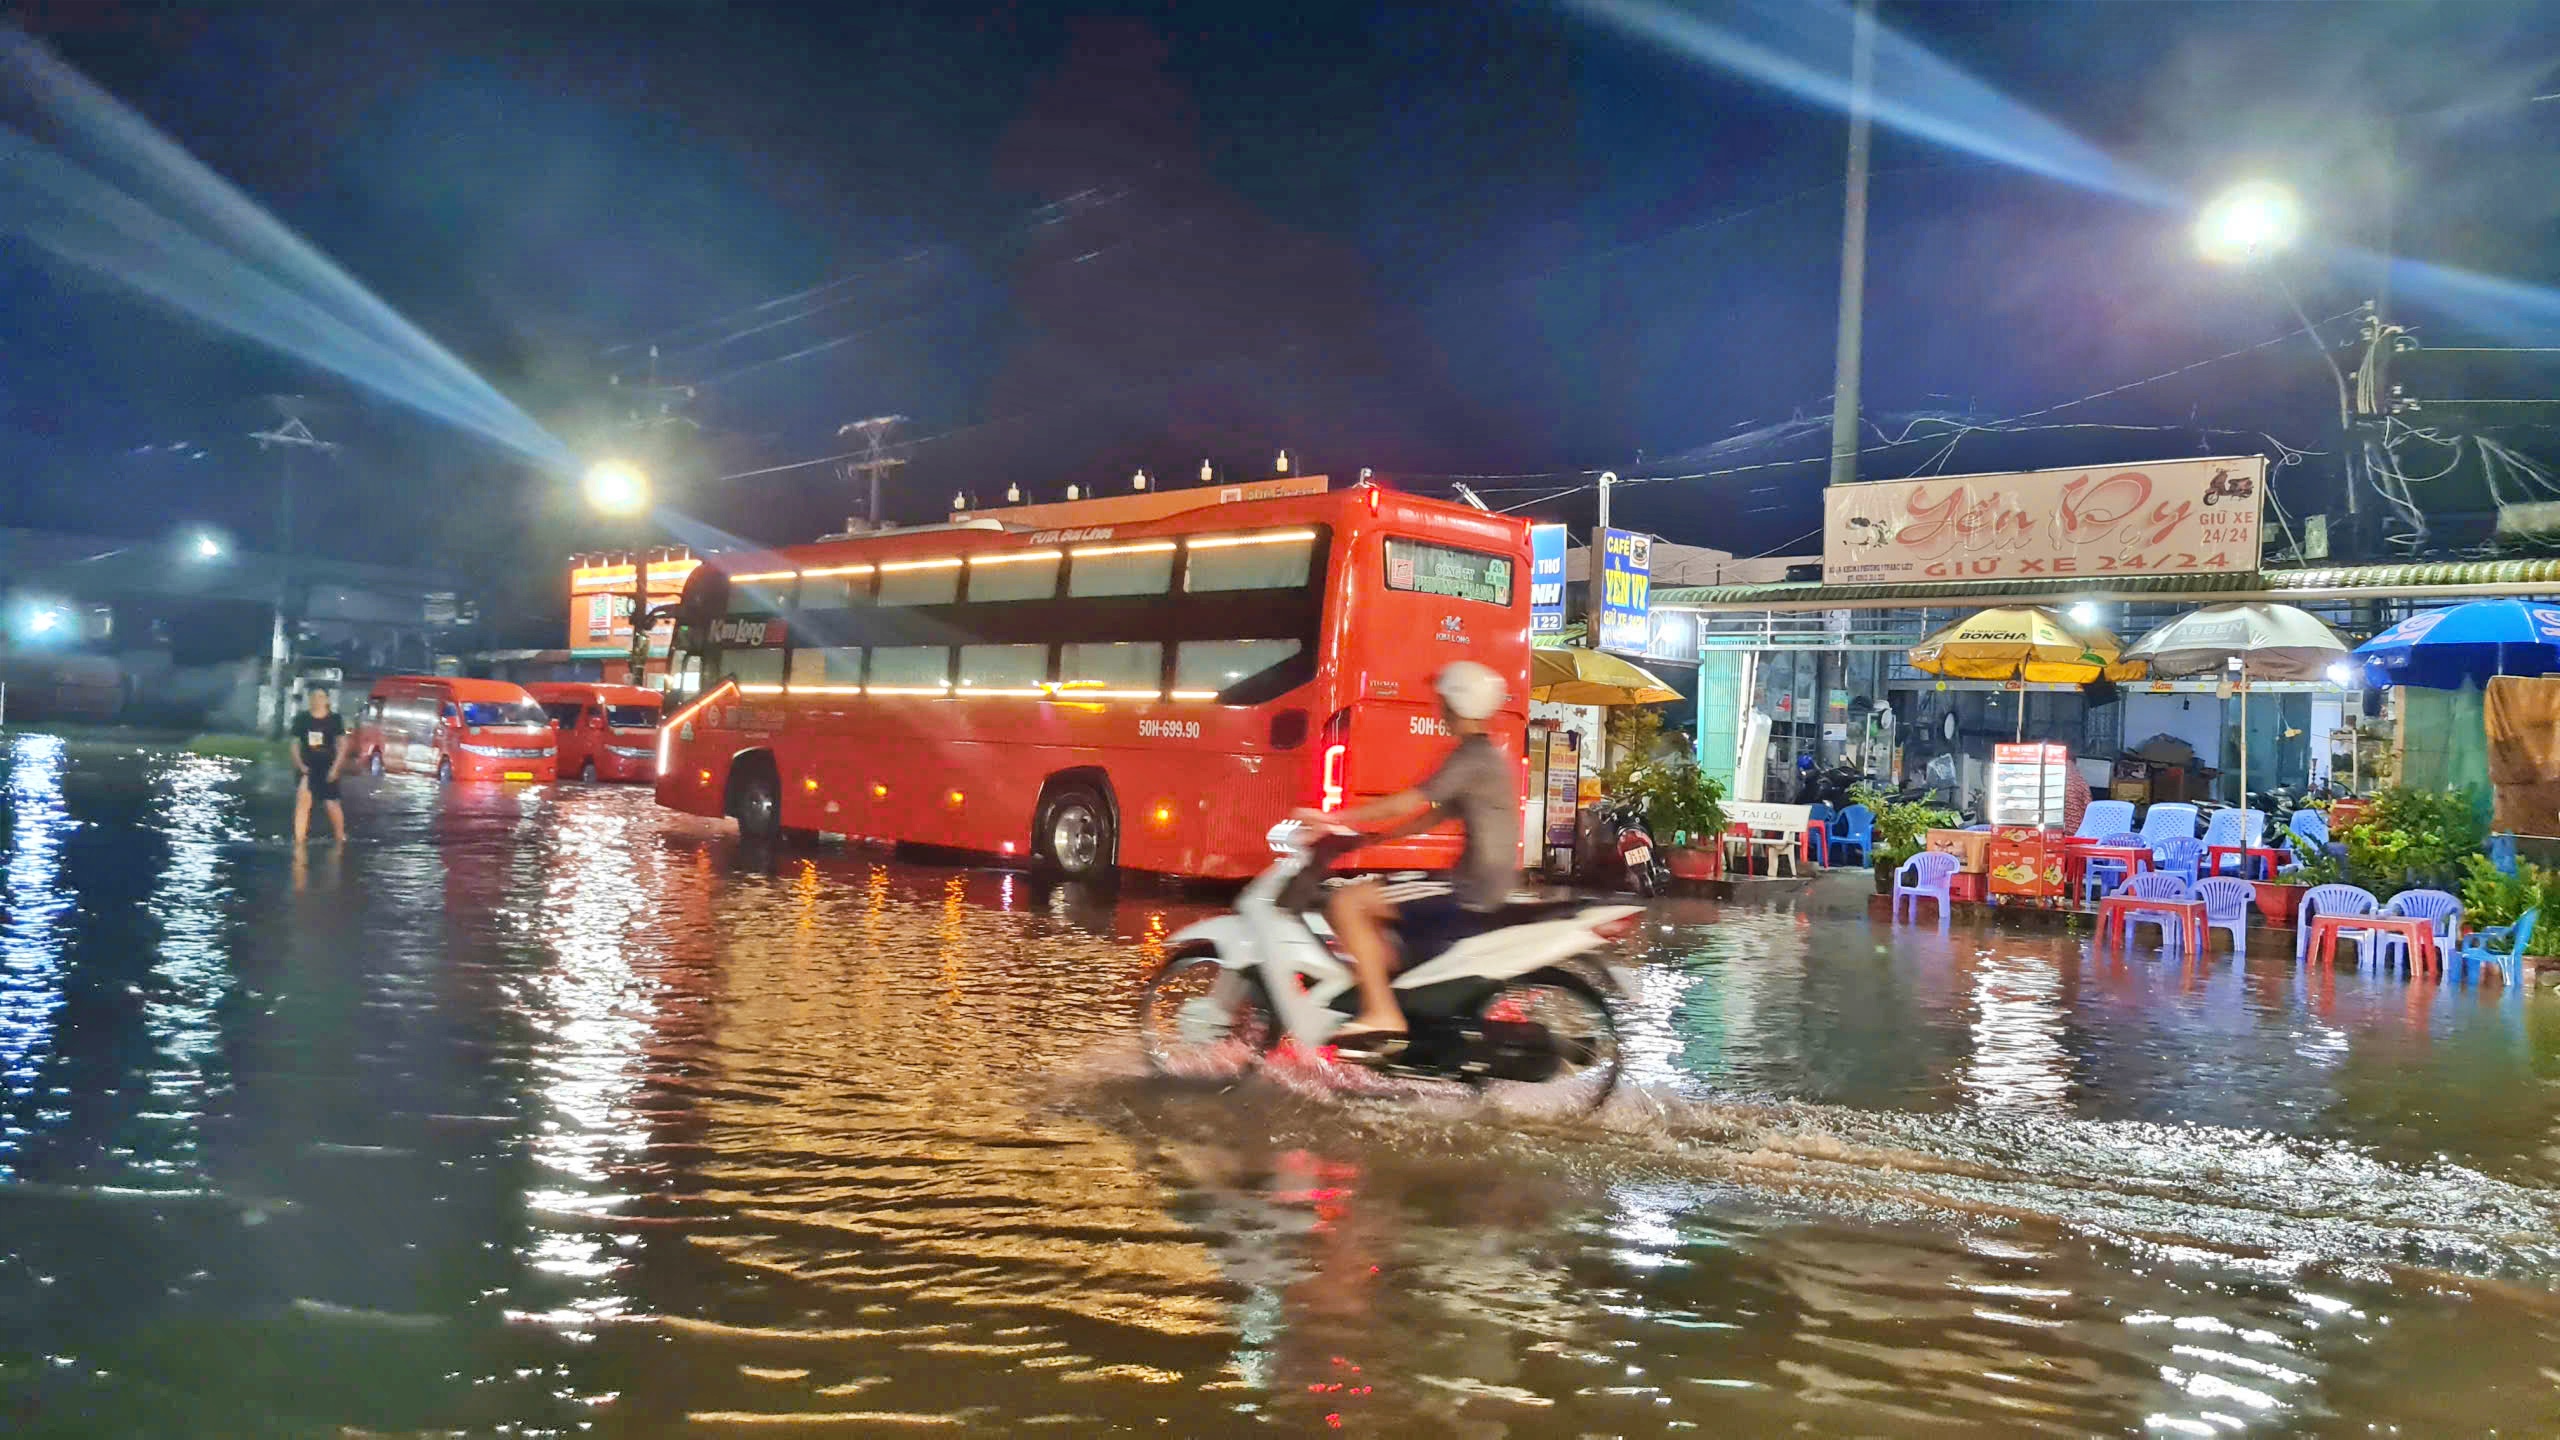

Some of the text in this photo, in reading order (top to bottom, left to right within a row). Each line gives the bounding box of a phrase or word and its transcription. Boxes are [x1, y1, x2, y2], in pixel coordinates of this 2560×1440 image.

[2200, 510, 2254, 525] GIỮ XE
[2202, 527, 2248, 543] 24/24
[1607, 536, 1630, 556] CAFÉ
[1493, 562, 1503, 574] 26
[1924, 556, 2001, 577] GIỮ
[2019, 556, 2078, 573] XE
[2097, 552, 2230, 570] 24/24
[1631, 573, 1649, 611] VY
[1959, 633, 2028, 641] BONCHA
[1139, 719, 1200, 739] 50H-699.90
